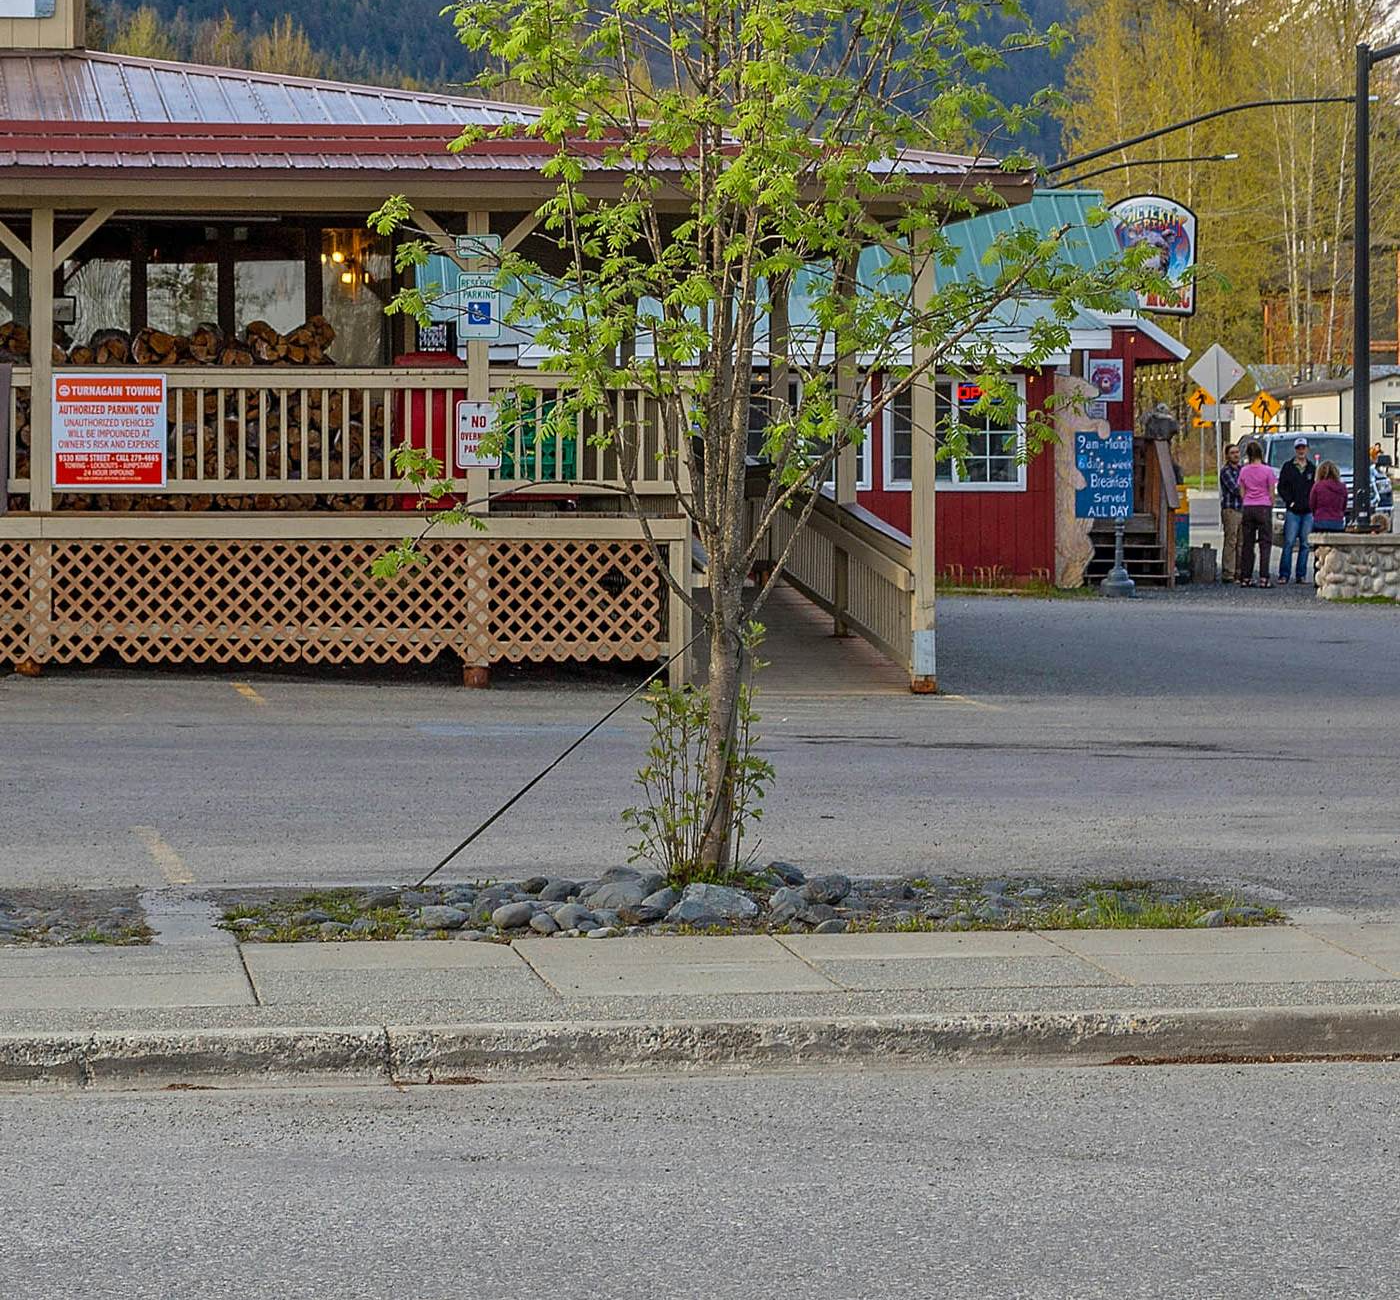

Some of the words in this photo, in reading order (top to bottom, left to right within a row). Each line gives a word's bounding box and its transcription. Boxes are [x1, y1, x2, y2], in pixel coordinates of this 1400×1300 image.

[461, 278, 498, 288] RESERVE
[463, 290, 497, 300] PARKING
[71, 385, 123, 397] TURNAGAIN
[125, 385, 161, 397] TOWING
[58, 404, 106, 415] AUTHORIZED
[107, 404, 139, 415] PARKING
[140, 404, 160, 415] ONLY
[63, 419, 119, 427] UNAUTHORIZED
[121, 419, 155, 427] VEHICLES
[471, 416, 487, 428] NO
[68, 429, 84, 438] WILL
[86, 429, 95, 438] BE
[97, 429, 140, 438] IMPOUNDED
[141, 429, 150, 438] AT
[58, 440, 92, 449] OWNER'S
[93, 440, 109, 449] RISK
[111, 440, 126, 449] AND
[127, 440, 160, 449] EXPENSE
[89, 454, 111, 462] STREET
[116, 454, 129, 462] CALL
[1090, 472, 1132, 488] Breakfast
[1087, 505, 1108, 517] ALL
[1110, 504, 1129, 517] DAY
